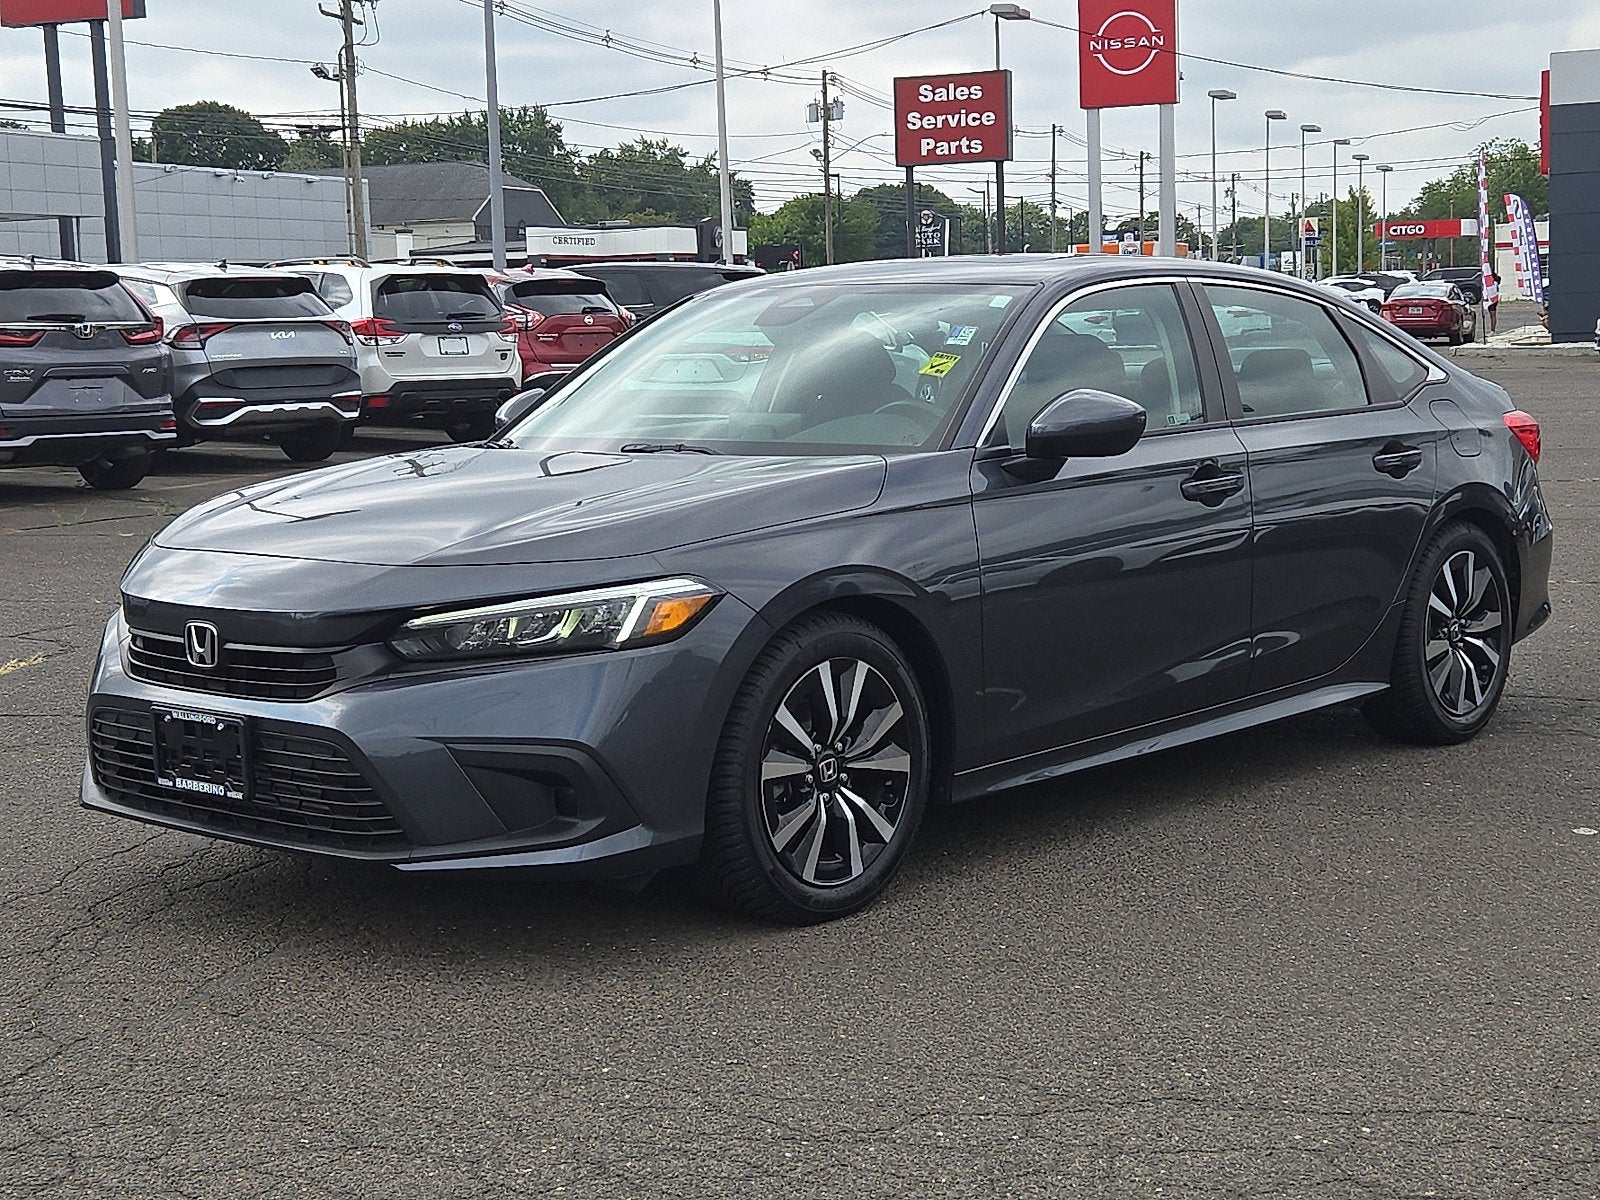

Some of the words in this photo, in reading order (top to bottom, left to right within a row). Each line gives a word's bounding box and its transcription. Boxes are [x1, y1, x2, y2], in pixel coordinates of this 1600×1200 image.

[1089, 35, 1165, 51] NISSAN
[918, 82, 983, 102] Sales
[906, 109, 996, 130] Service
[920, 136, 983, 156] Parts
[915, 231, 941, 239] AUTO
[1389, 224, 1426, 236] CITGO
[552, 236, 596, 246] CERTIFIED
[270, 330, 296, 340] KIA
[175, 777, 225, 796] BARBERINO
